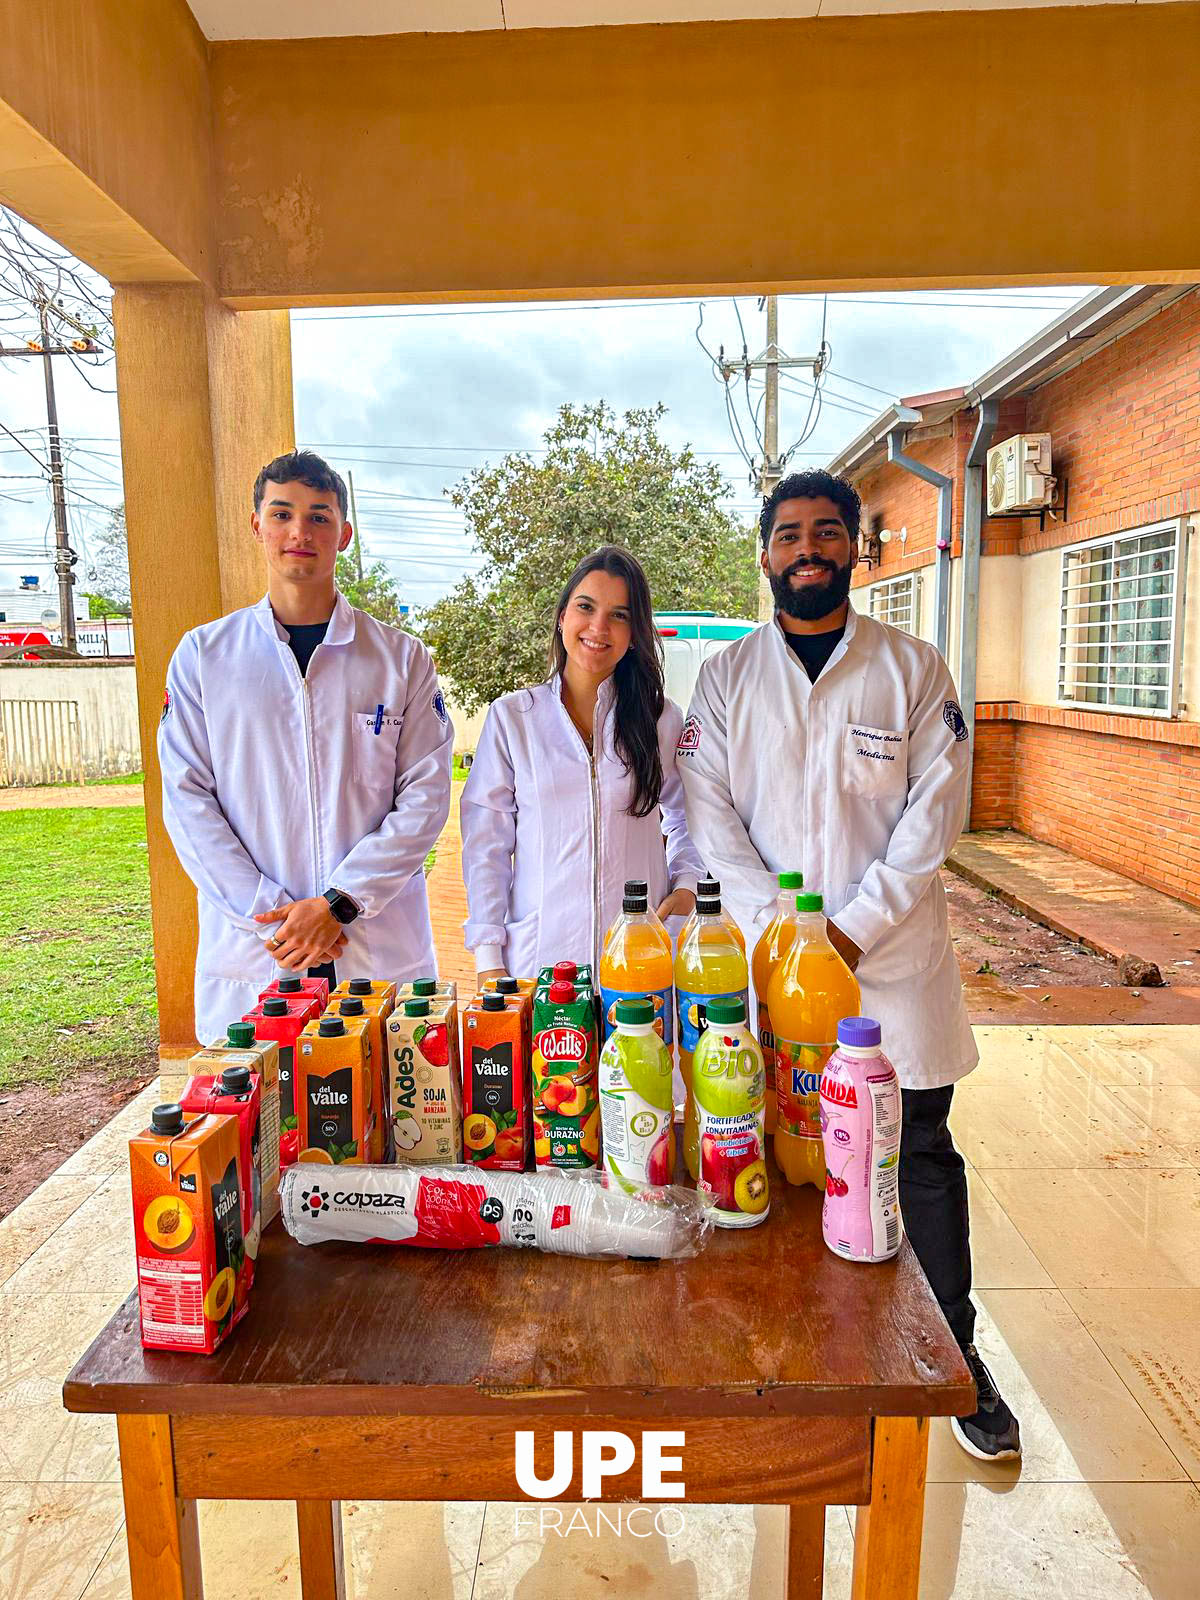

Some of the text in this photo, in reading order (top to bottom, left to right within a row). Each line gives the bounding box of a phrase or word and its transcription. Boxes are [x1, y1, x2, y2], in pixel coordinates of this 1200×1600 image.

[851, 729, 883, 740] Henrique
[857, 748, 895, 761] Medicina
[475, 1063, 509, 1076] Valle
[319, 1085, 331, 1093] del
[423, 1088, 447, 1101] SOJA
[310, 1091, 349, 1106] Valle
[707, 1111, 756, 1124] FORTIFICADO
[720, 1120, 760, 1135] VITAMINAS
[544, 1130, 586, 1139] DURAZNO
[214, 1190, 238, 1221] Valle
[333, 1191, 406, 1209] copaza
[483, 1204, 501, 1218] PS
